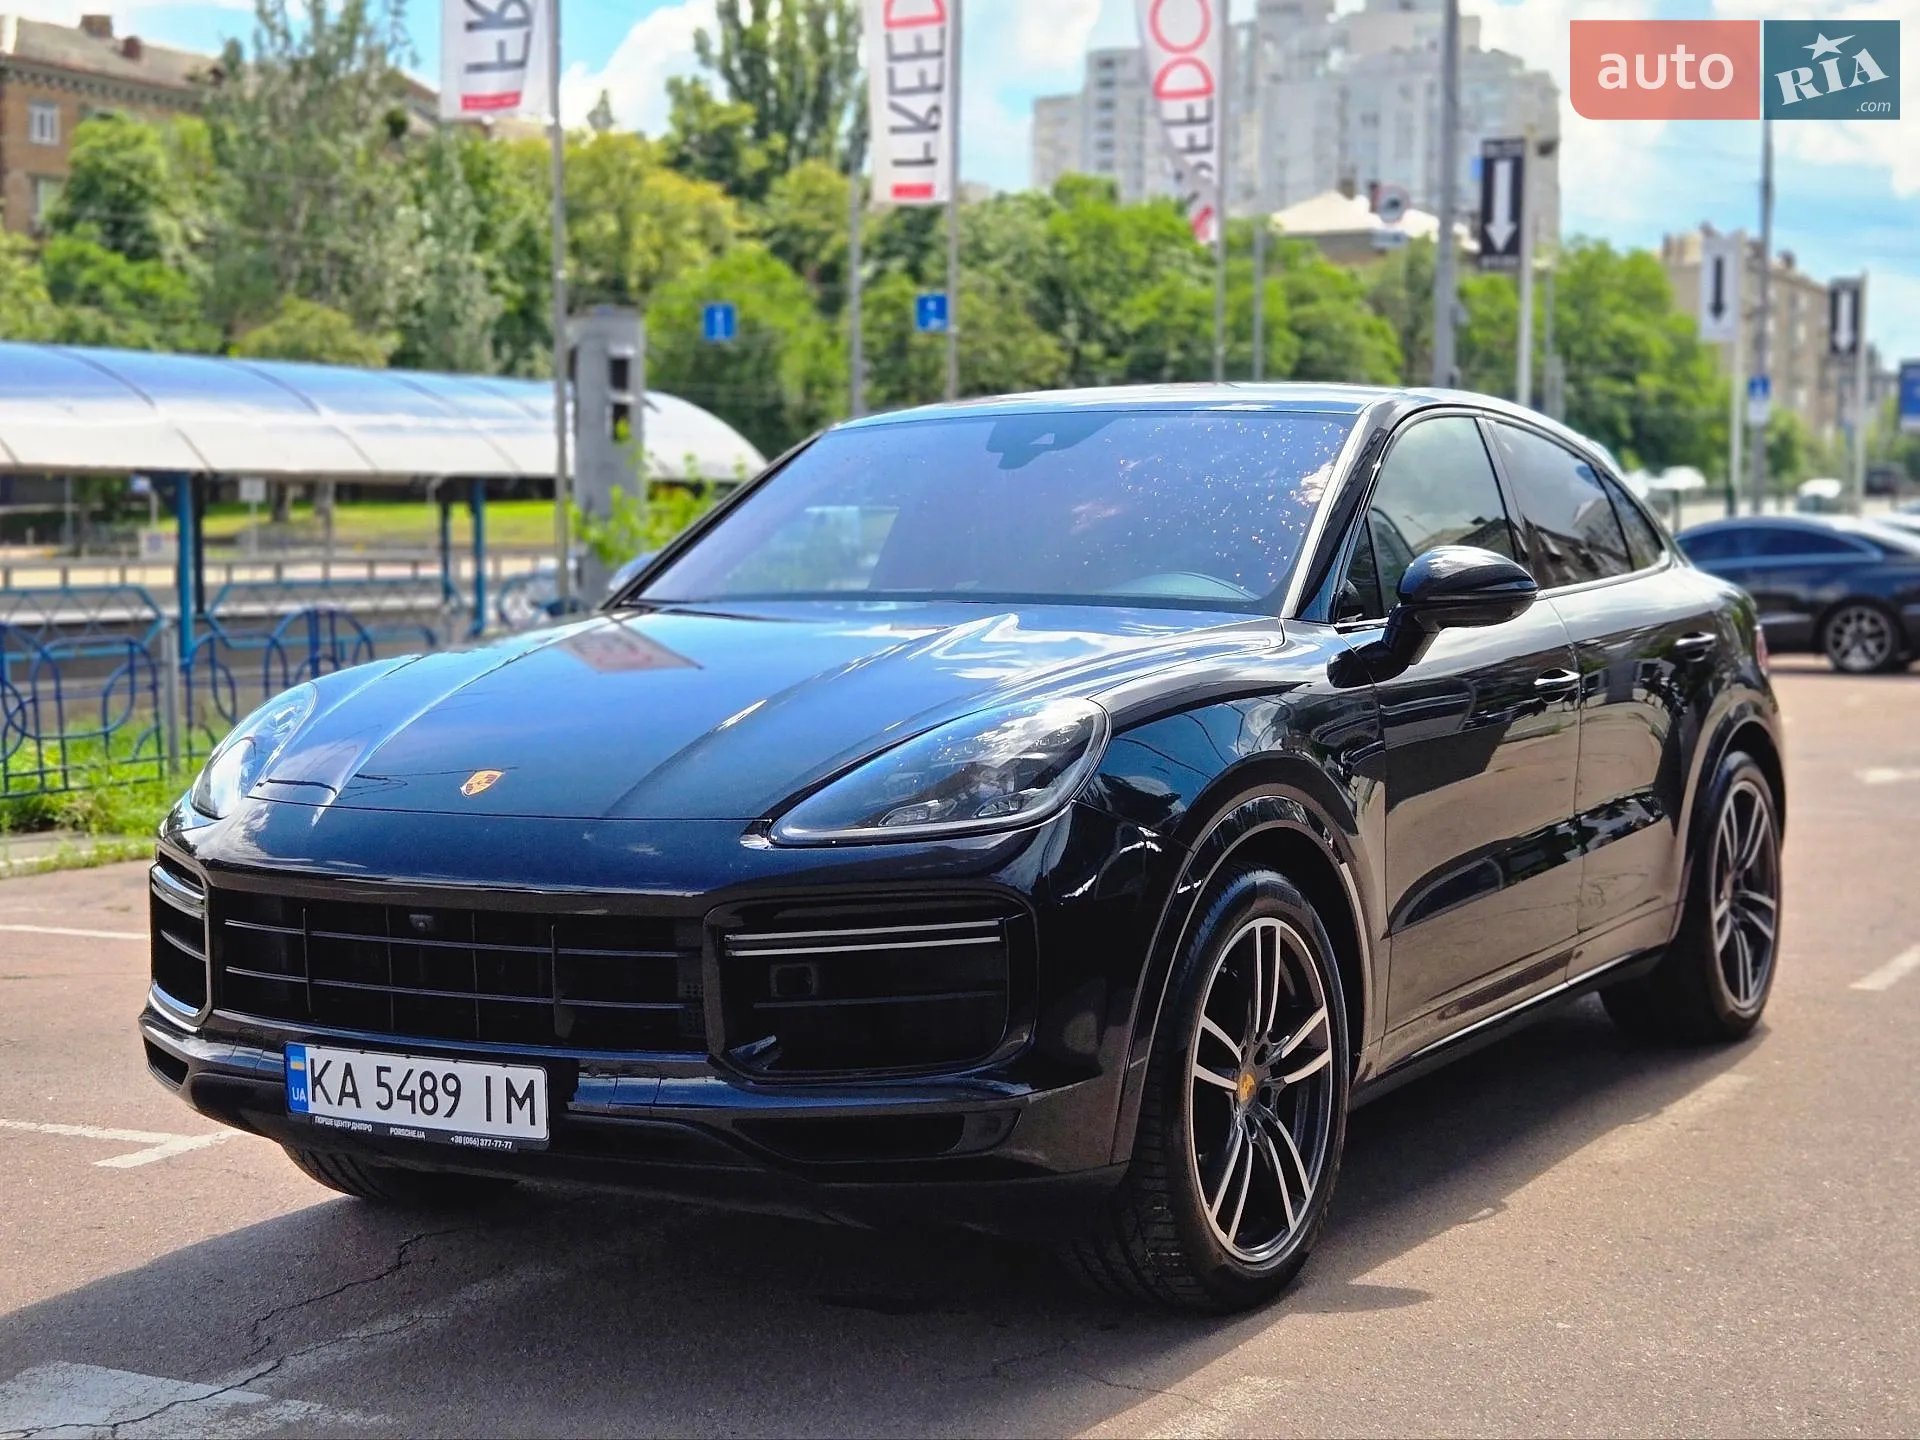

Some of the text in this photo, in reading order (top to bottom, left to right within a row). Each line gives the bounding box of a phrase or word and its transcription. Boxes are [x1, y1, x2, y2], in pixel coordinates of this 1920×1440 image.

[292, 1087, 306, 1103] UA
[309, 1057, 536, 1126] KA 5489 IM
